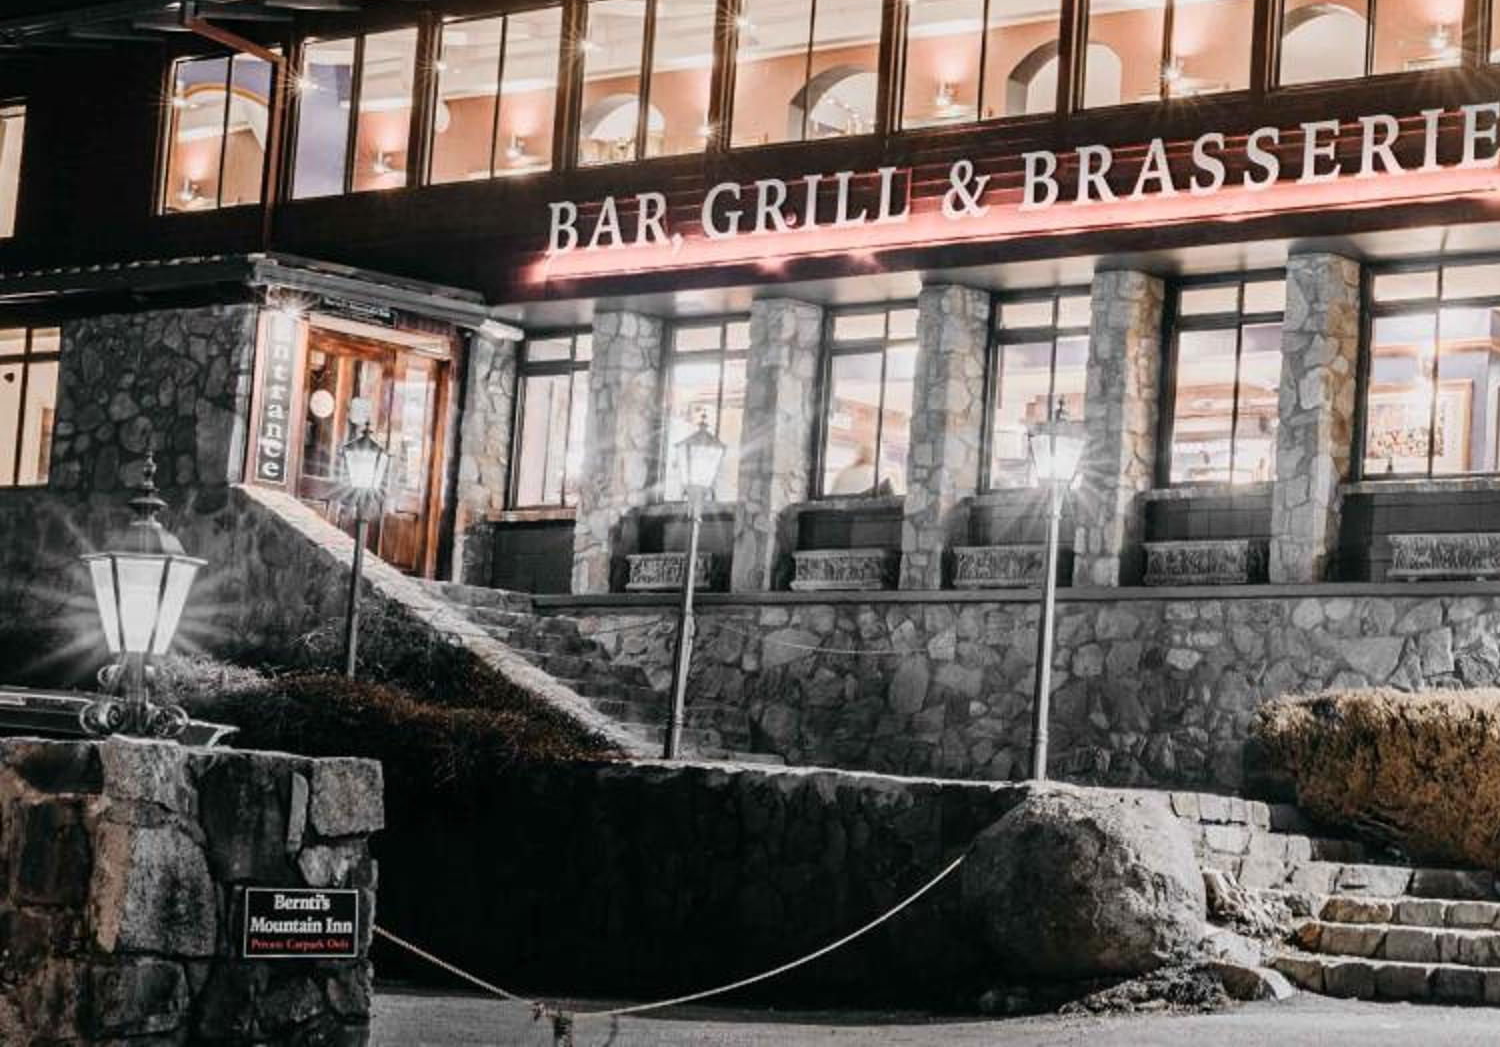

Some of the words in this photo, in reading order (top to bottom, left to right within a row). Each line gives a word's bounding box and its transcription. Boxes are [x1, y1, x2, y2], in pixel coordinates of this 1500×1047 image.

[702, 165, 911, 241] GRILL
[941, 159, 992, 220] &
[262, 313, 291, 478] ntrance
[250, 916, 322, 934] Mountain
[325, 917, 353, 934] Inn
[273, 894, 330, 911] Bernti's
